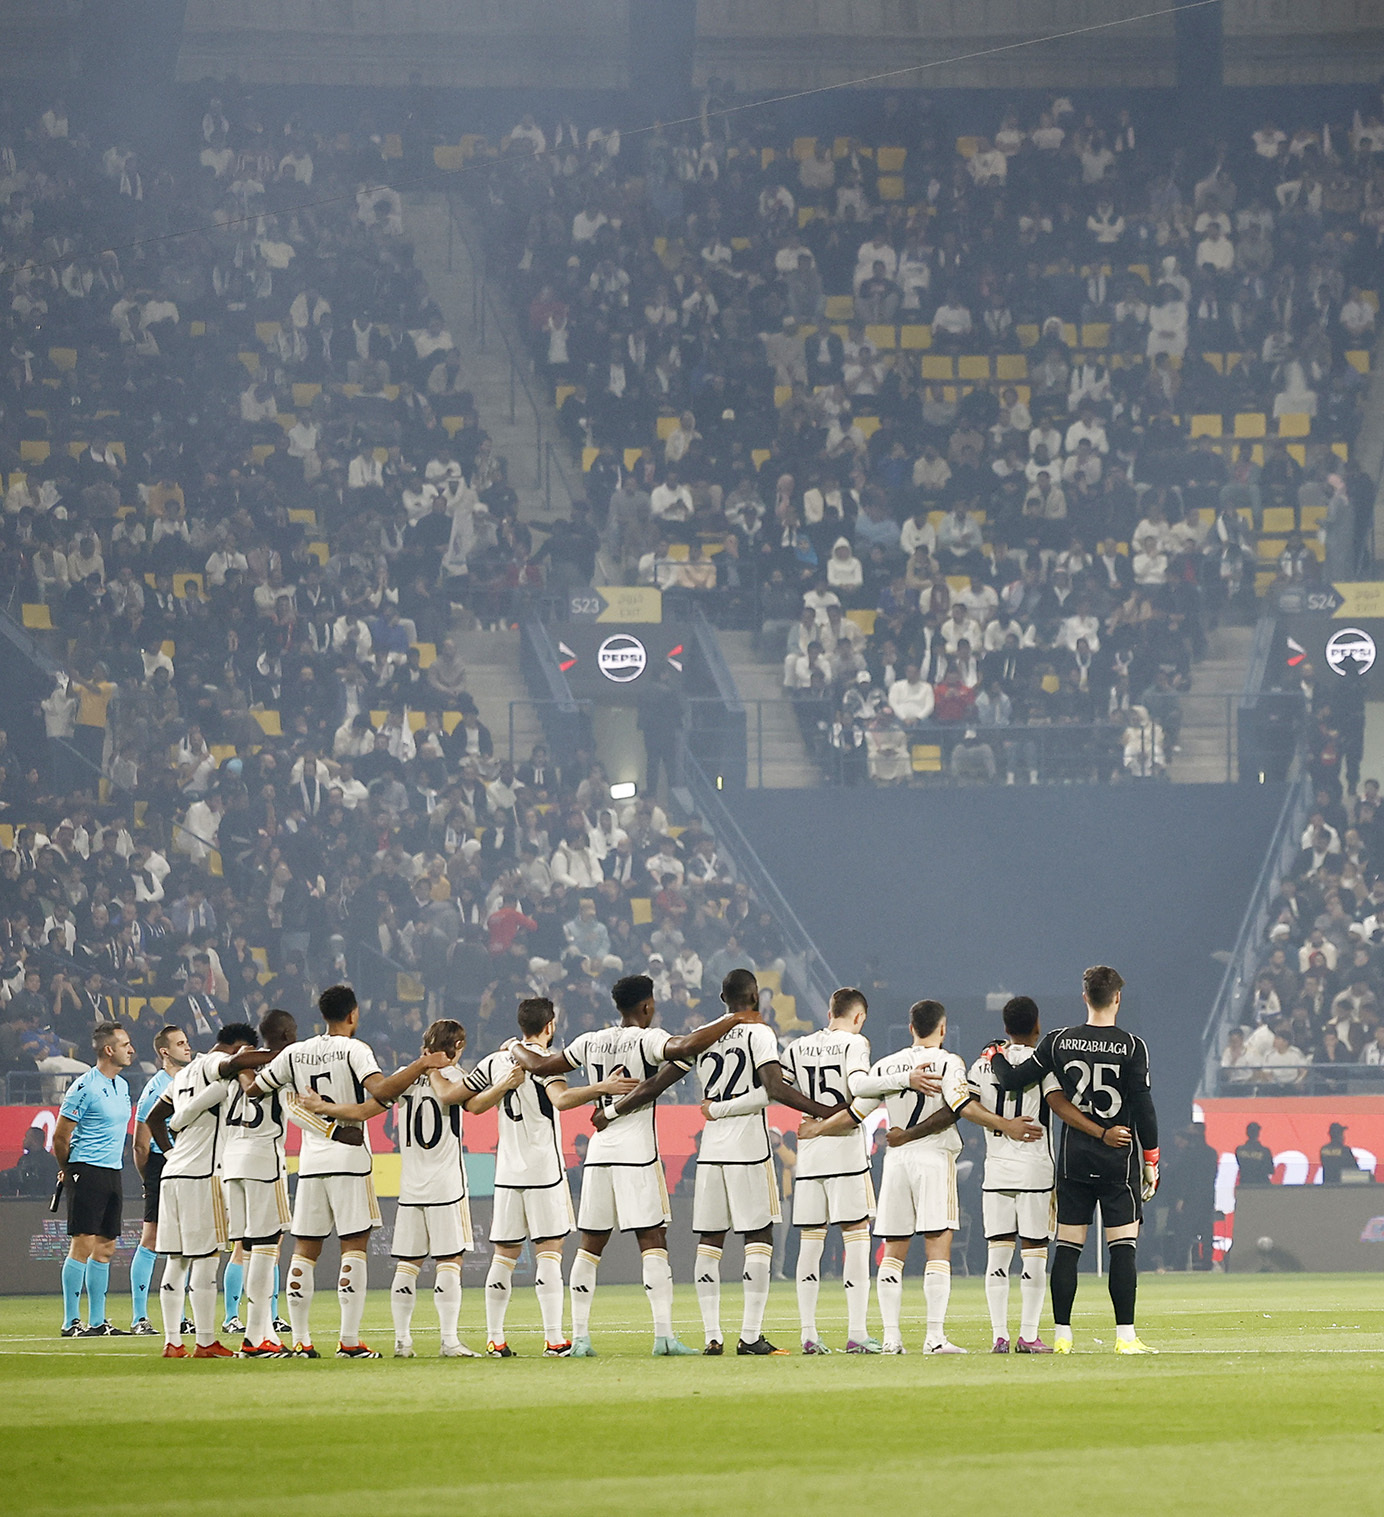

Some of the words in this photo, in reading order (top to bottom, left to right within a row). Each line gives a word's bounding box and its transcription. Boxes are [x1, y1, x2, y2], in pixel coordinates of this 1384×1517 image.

[571, 597, 600, 614] S23
[1308, 593, 1336, 610] S24
[602, 653, 642, 662] PEPSI
[1331, 648, 1371, 657] PEPSI
[798, 1043, 845, 1059] VALVERDE
[1058, 1038, 1128, 1057] ARRIZABALAGA
[294, 1050, 347, 1067] BELLINGHAM
[699, 1047, 750, 1103] 22
[802, 1065, 848, 1108] 15
[1063, 1059, 1123, 1119] 25
[402, 1094, 443, 1150] 10
